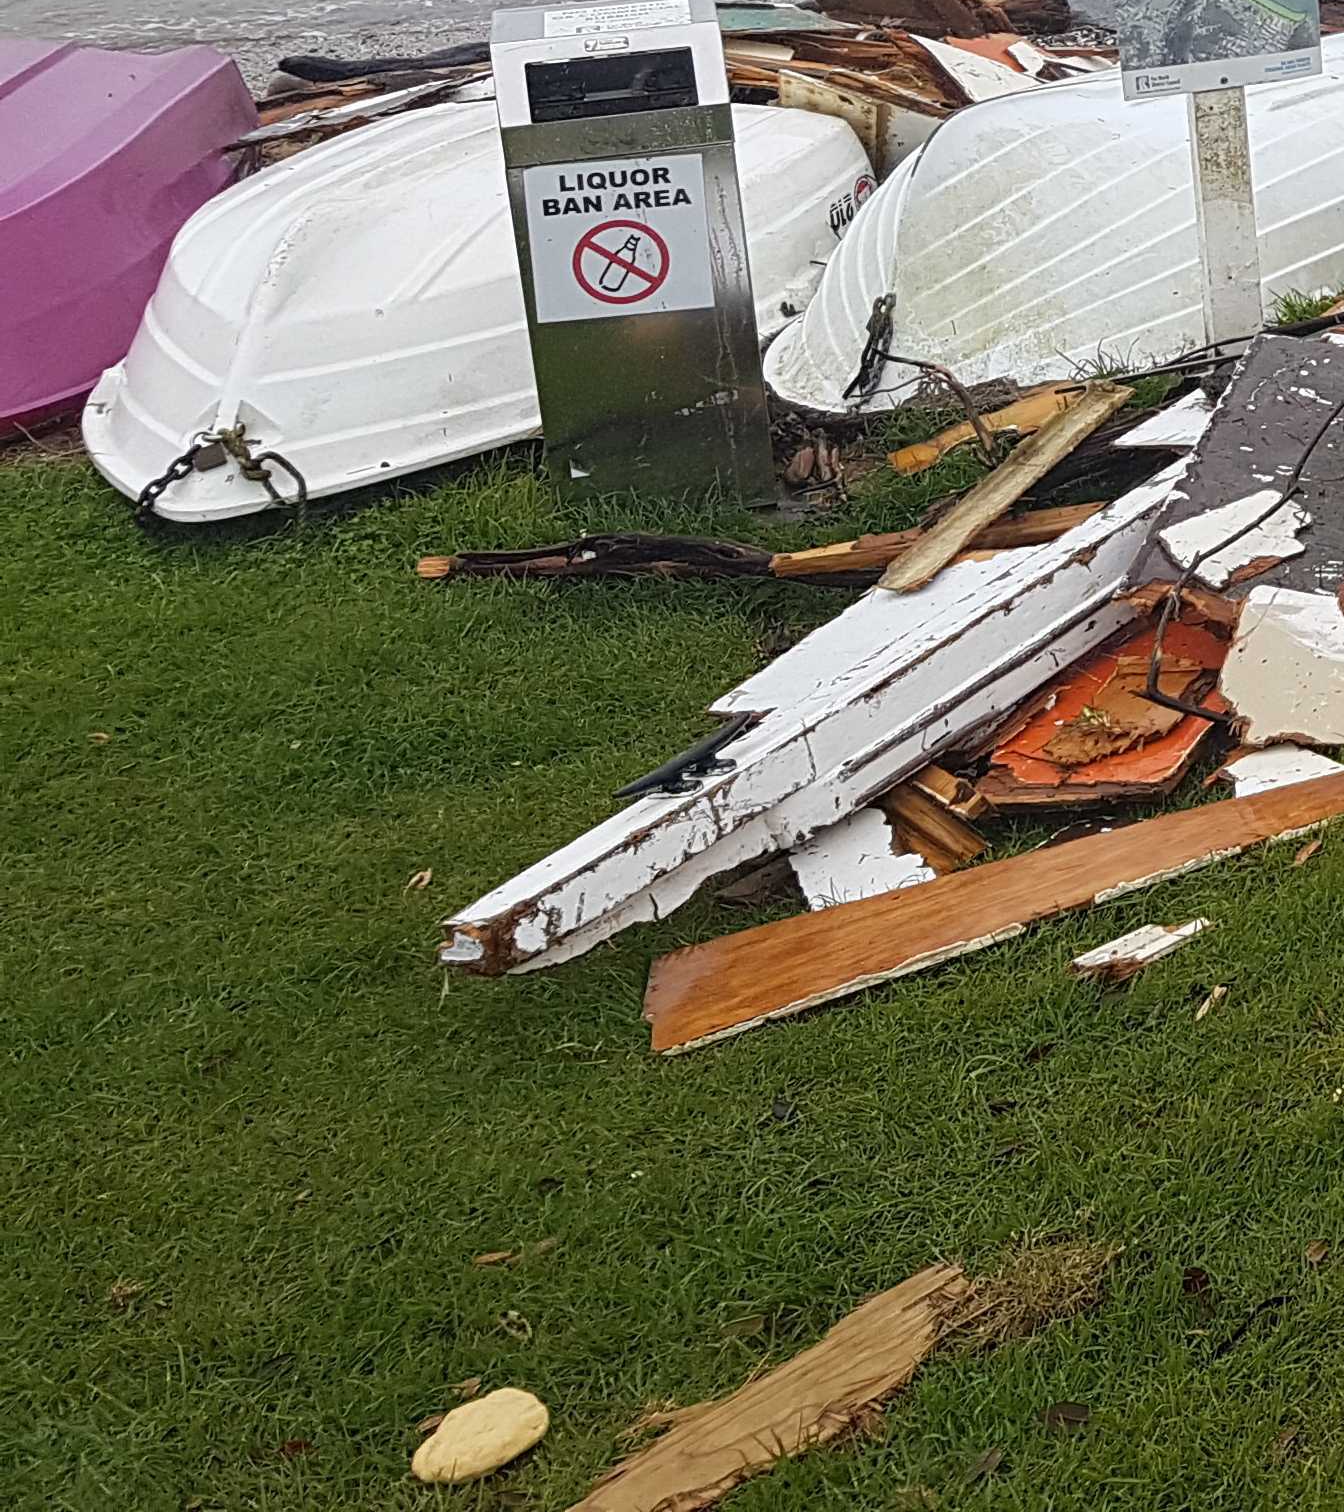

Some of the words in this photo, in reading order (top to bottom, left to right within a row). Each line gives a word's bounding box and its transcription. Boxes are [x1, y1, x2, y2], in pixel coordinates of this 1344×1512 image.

[558, 167, 672, 192] LIQUOR
[542, 195, 602, 216] BAN
[612, 188, 692, 211] AREA
